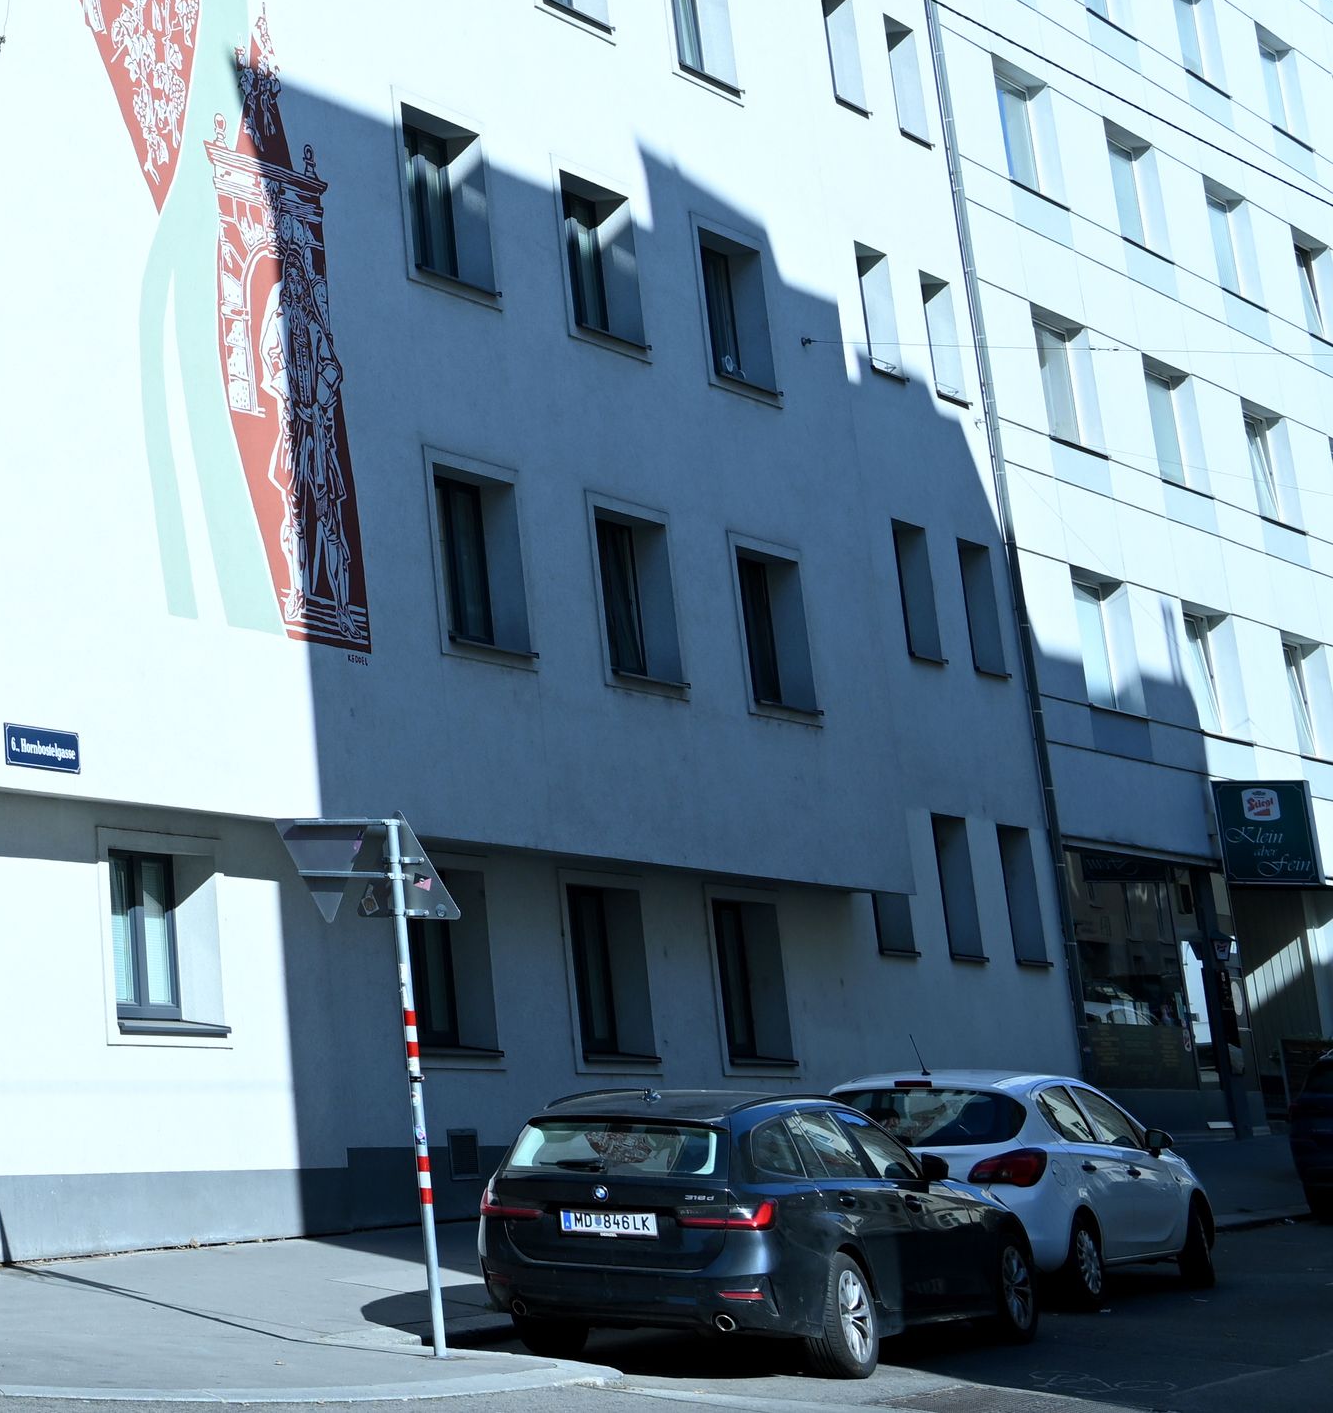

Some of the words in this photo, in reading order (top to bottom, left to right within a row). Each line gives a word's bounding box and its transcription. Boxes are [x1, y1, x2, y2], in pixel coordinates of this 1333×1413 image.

[20, 738, 76, 761] Hornbostelgasse
[1247, 797, 1274, 812] Stiegl
[1225, 826, 1283, 844] Klein
[1253, 845, 1277, 857] aber
[1257, 853, 1312, 877] Fein
[574, 1212, 593, 1228] MD
